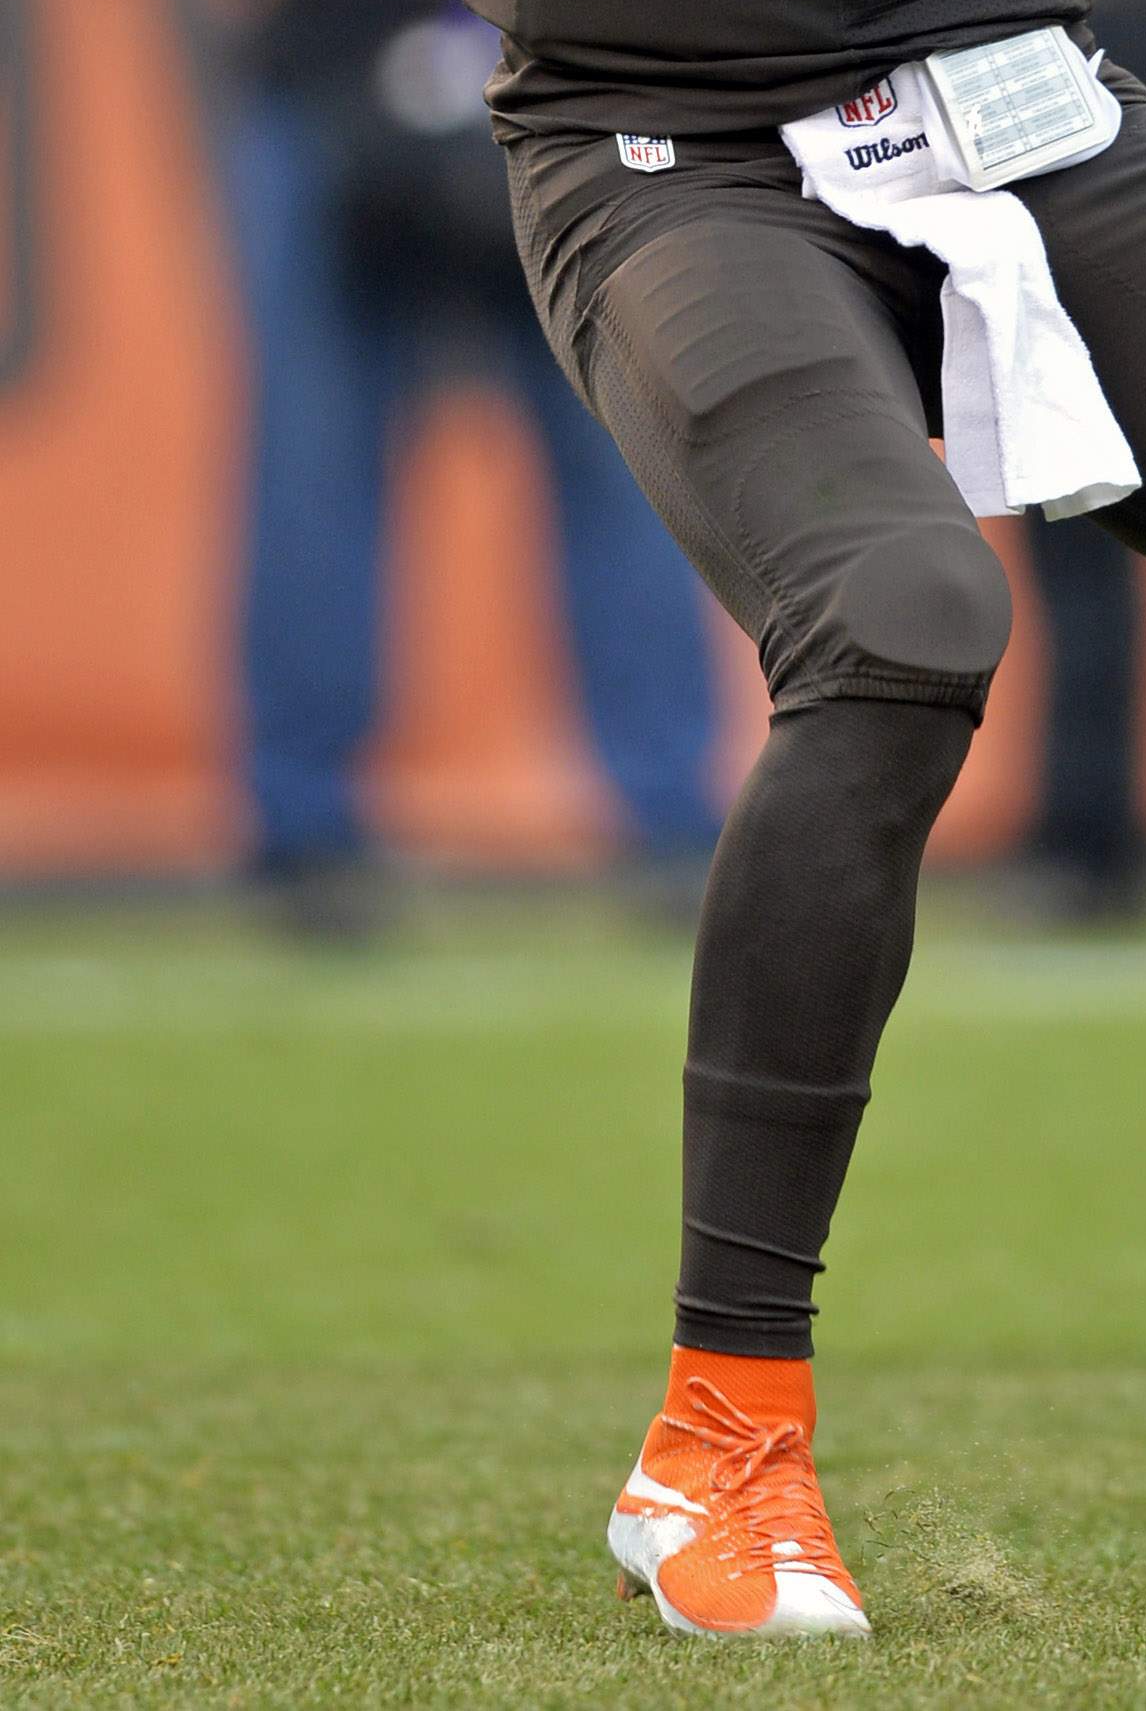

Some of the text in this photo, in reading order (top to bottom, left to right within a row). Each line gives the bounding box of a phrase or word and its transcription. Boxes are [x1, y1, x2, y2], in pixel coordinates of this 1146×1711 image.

[843, 78, 893, 123] NFL
[629, 145, 667, 163] NFL
[846, 131, 930, 171] Wilson
